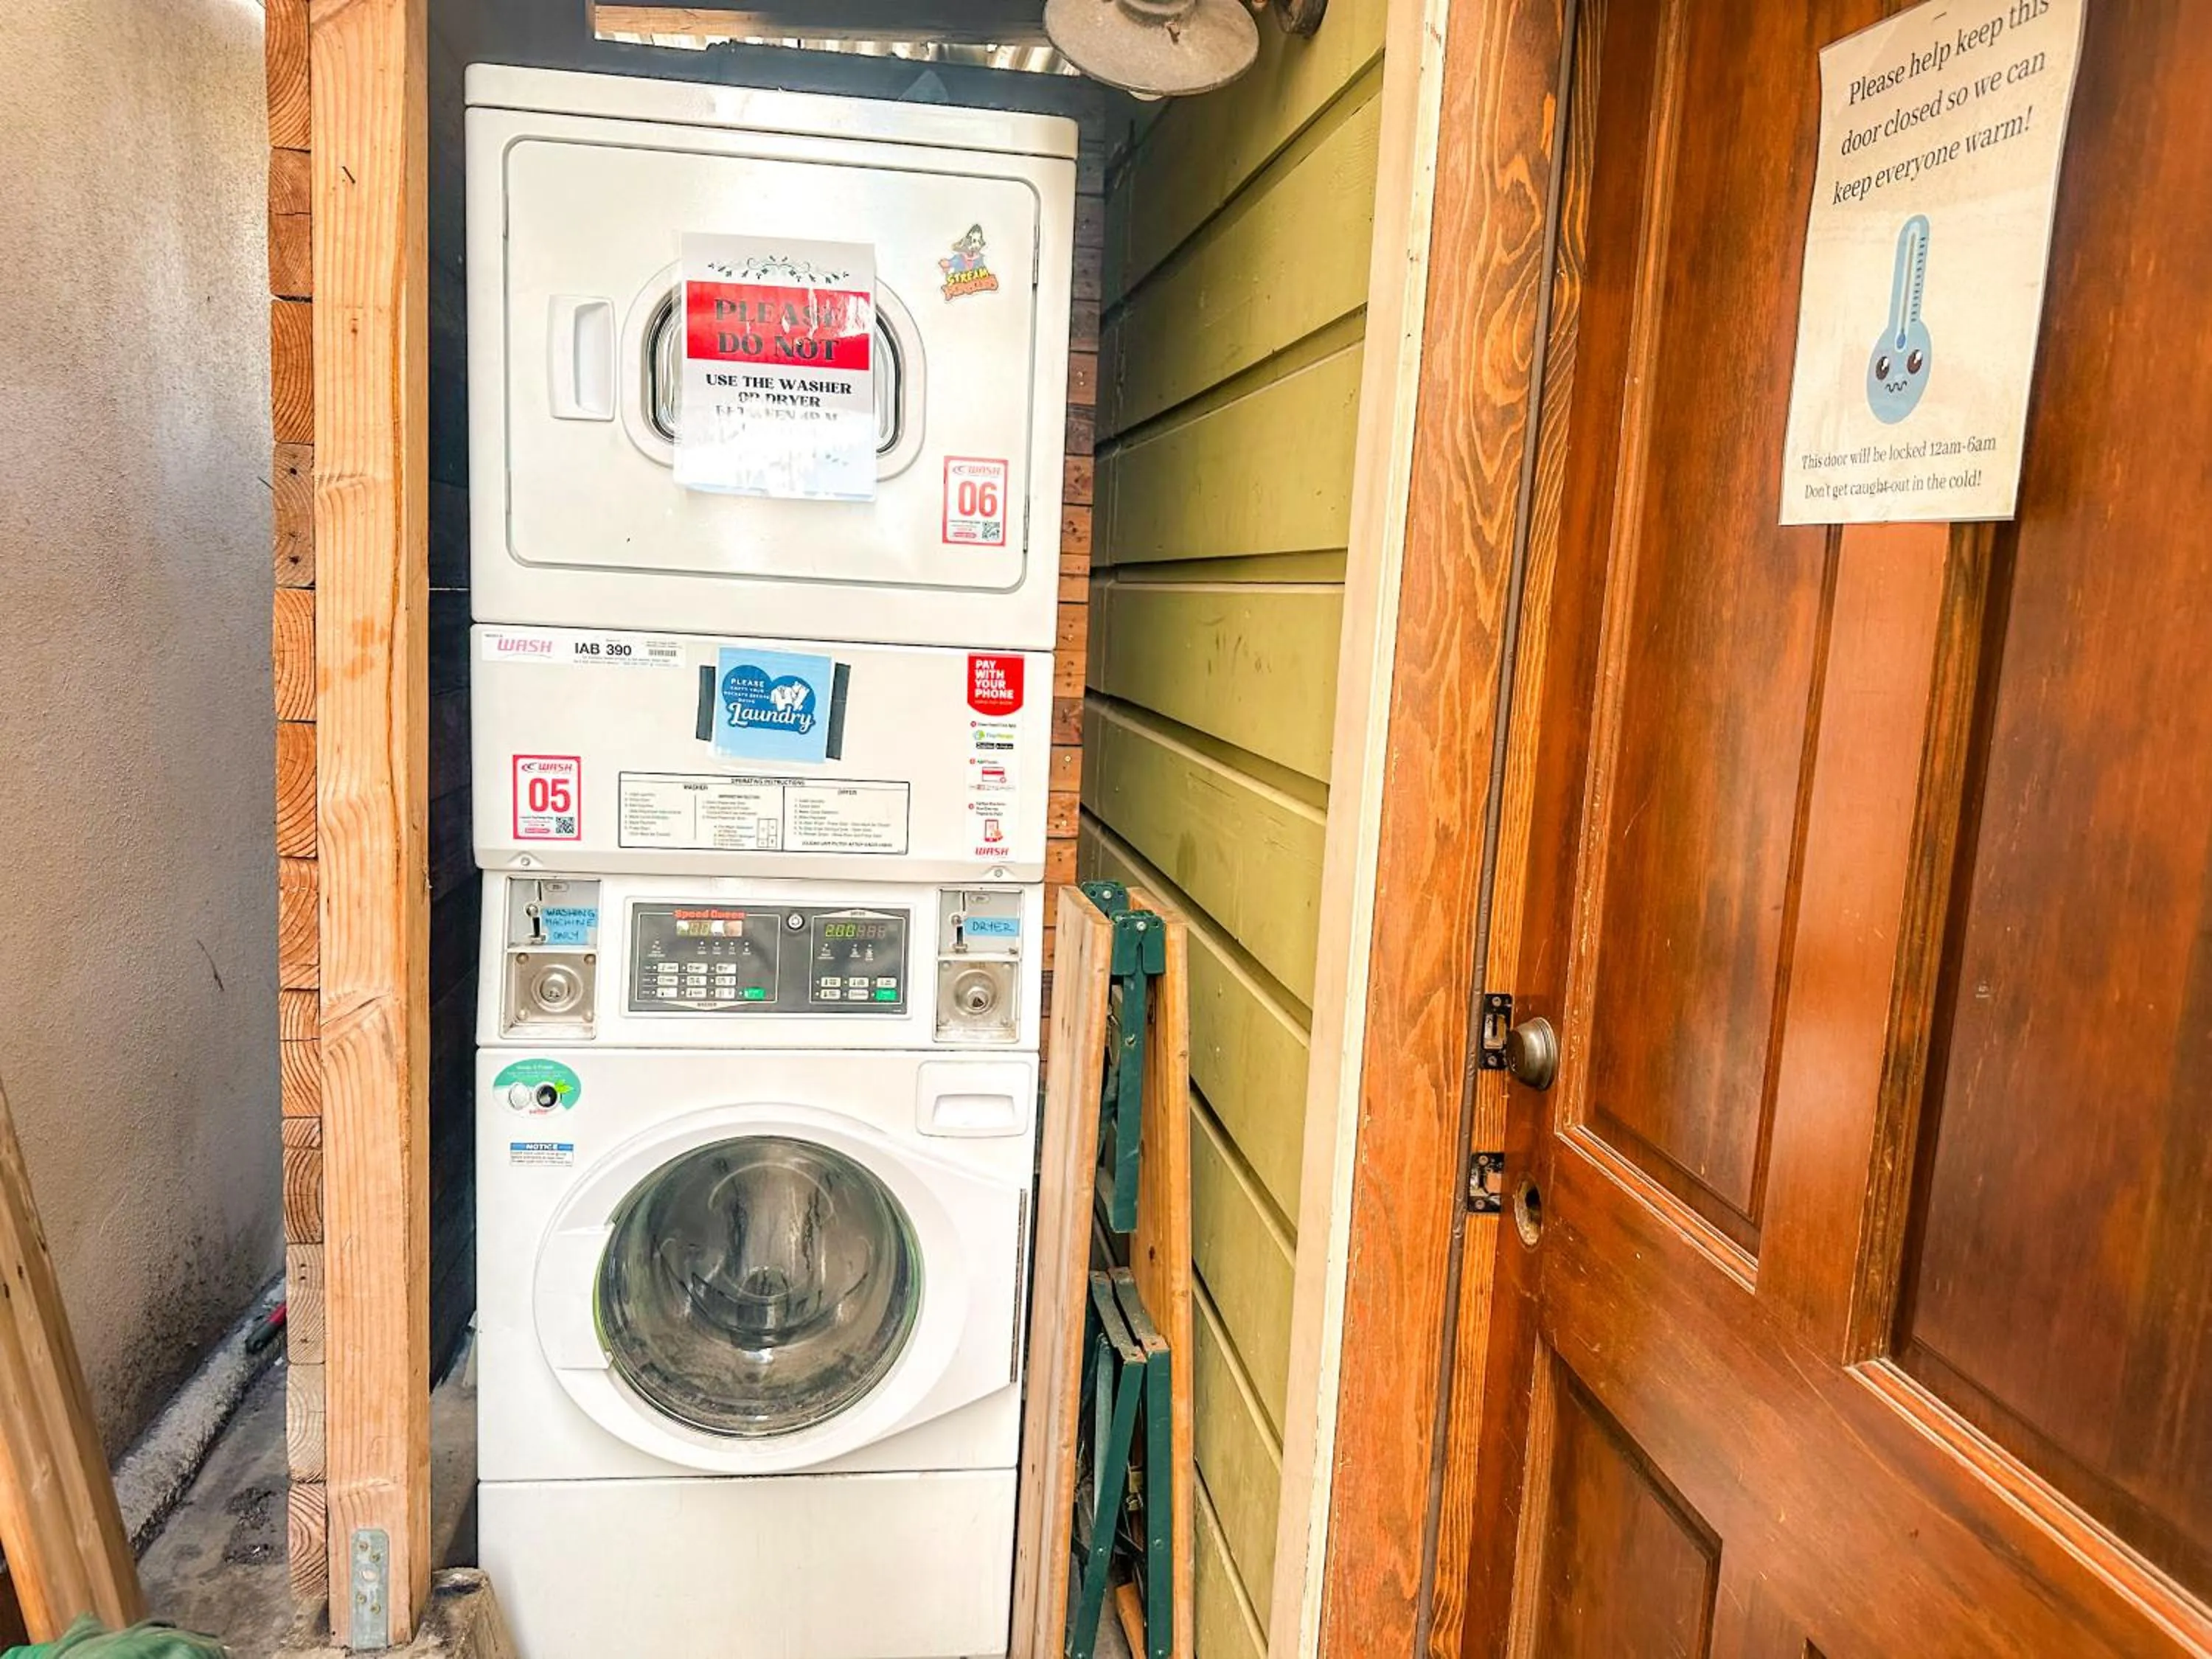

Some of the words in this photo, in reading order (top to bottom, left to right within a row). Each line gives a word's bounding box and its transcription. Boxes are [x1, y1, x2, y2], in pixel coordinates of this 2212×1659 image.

[1849, 63, 1905, 106] Please
[1909, 41, 1952, 78] help
[1955, 16, 2003, 56] keep
[1841, 123, 1882, 156] door
[1884, 89, 1944, 138] closed
[1947, 86, 1969, 112] so
[1974, 71, 2002, 98] we
[2007, 51, 2045, 80] can
[1832, 174, 1872, 205] keep
[1874, 140, 1961, 187] everyone
[1966, 105, 2033, 153] warm!
[718, 331, 762, 355] DO
[774, 335, 839, 360] NOT
[706, 374, 737, 386] USE
[742, 376, 774, 389] THE
[779, 378, 852, 394] WASHER
[765, 393, 821, 407] DRYER
[1801, 454, 1823, 470] This
[1824, 452, 1848, 467] door
[1850, 447, 1871, 464] will
[1873, 446, 1886, 462] be
[1888, 442, 1927, 461] locked
[1930, 436, 1996, 457] 12am-6am
[1805, 484, 1830, 498] Don't
[1832, 483, 1848, 500] get
[1850, 478, 1888, 496] caught
[1891, 479, 1909, 493] out
[1913, 475, 1924, 490] in
[1927, 473, 1946, 490] the
[1949, 470, 1982, 488] cold!
[959, 481, 998, 517] 06
[498, 639, 552, 653] WASH
[575, 642, 600, 655] IAB
[606, 644, 632, 656] 390
[975, 660, 996, 669] PAY
[975, 669, 1005, 679] WITH
[731, 678, 765, 687] PLEASE
[975, 679, 1006, 689] YOUR
[975, 689, 1015, 699] PHONE
[727, 702, 813, 731] Laundry
[529, 778, 571, 813] 05
[975, 847, 1009, 856] WASH
[546, 909, 595, 917] WASHING
[675, 909, 709, 919] Speed
[973, 921, 1015, 932] DRYER
